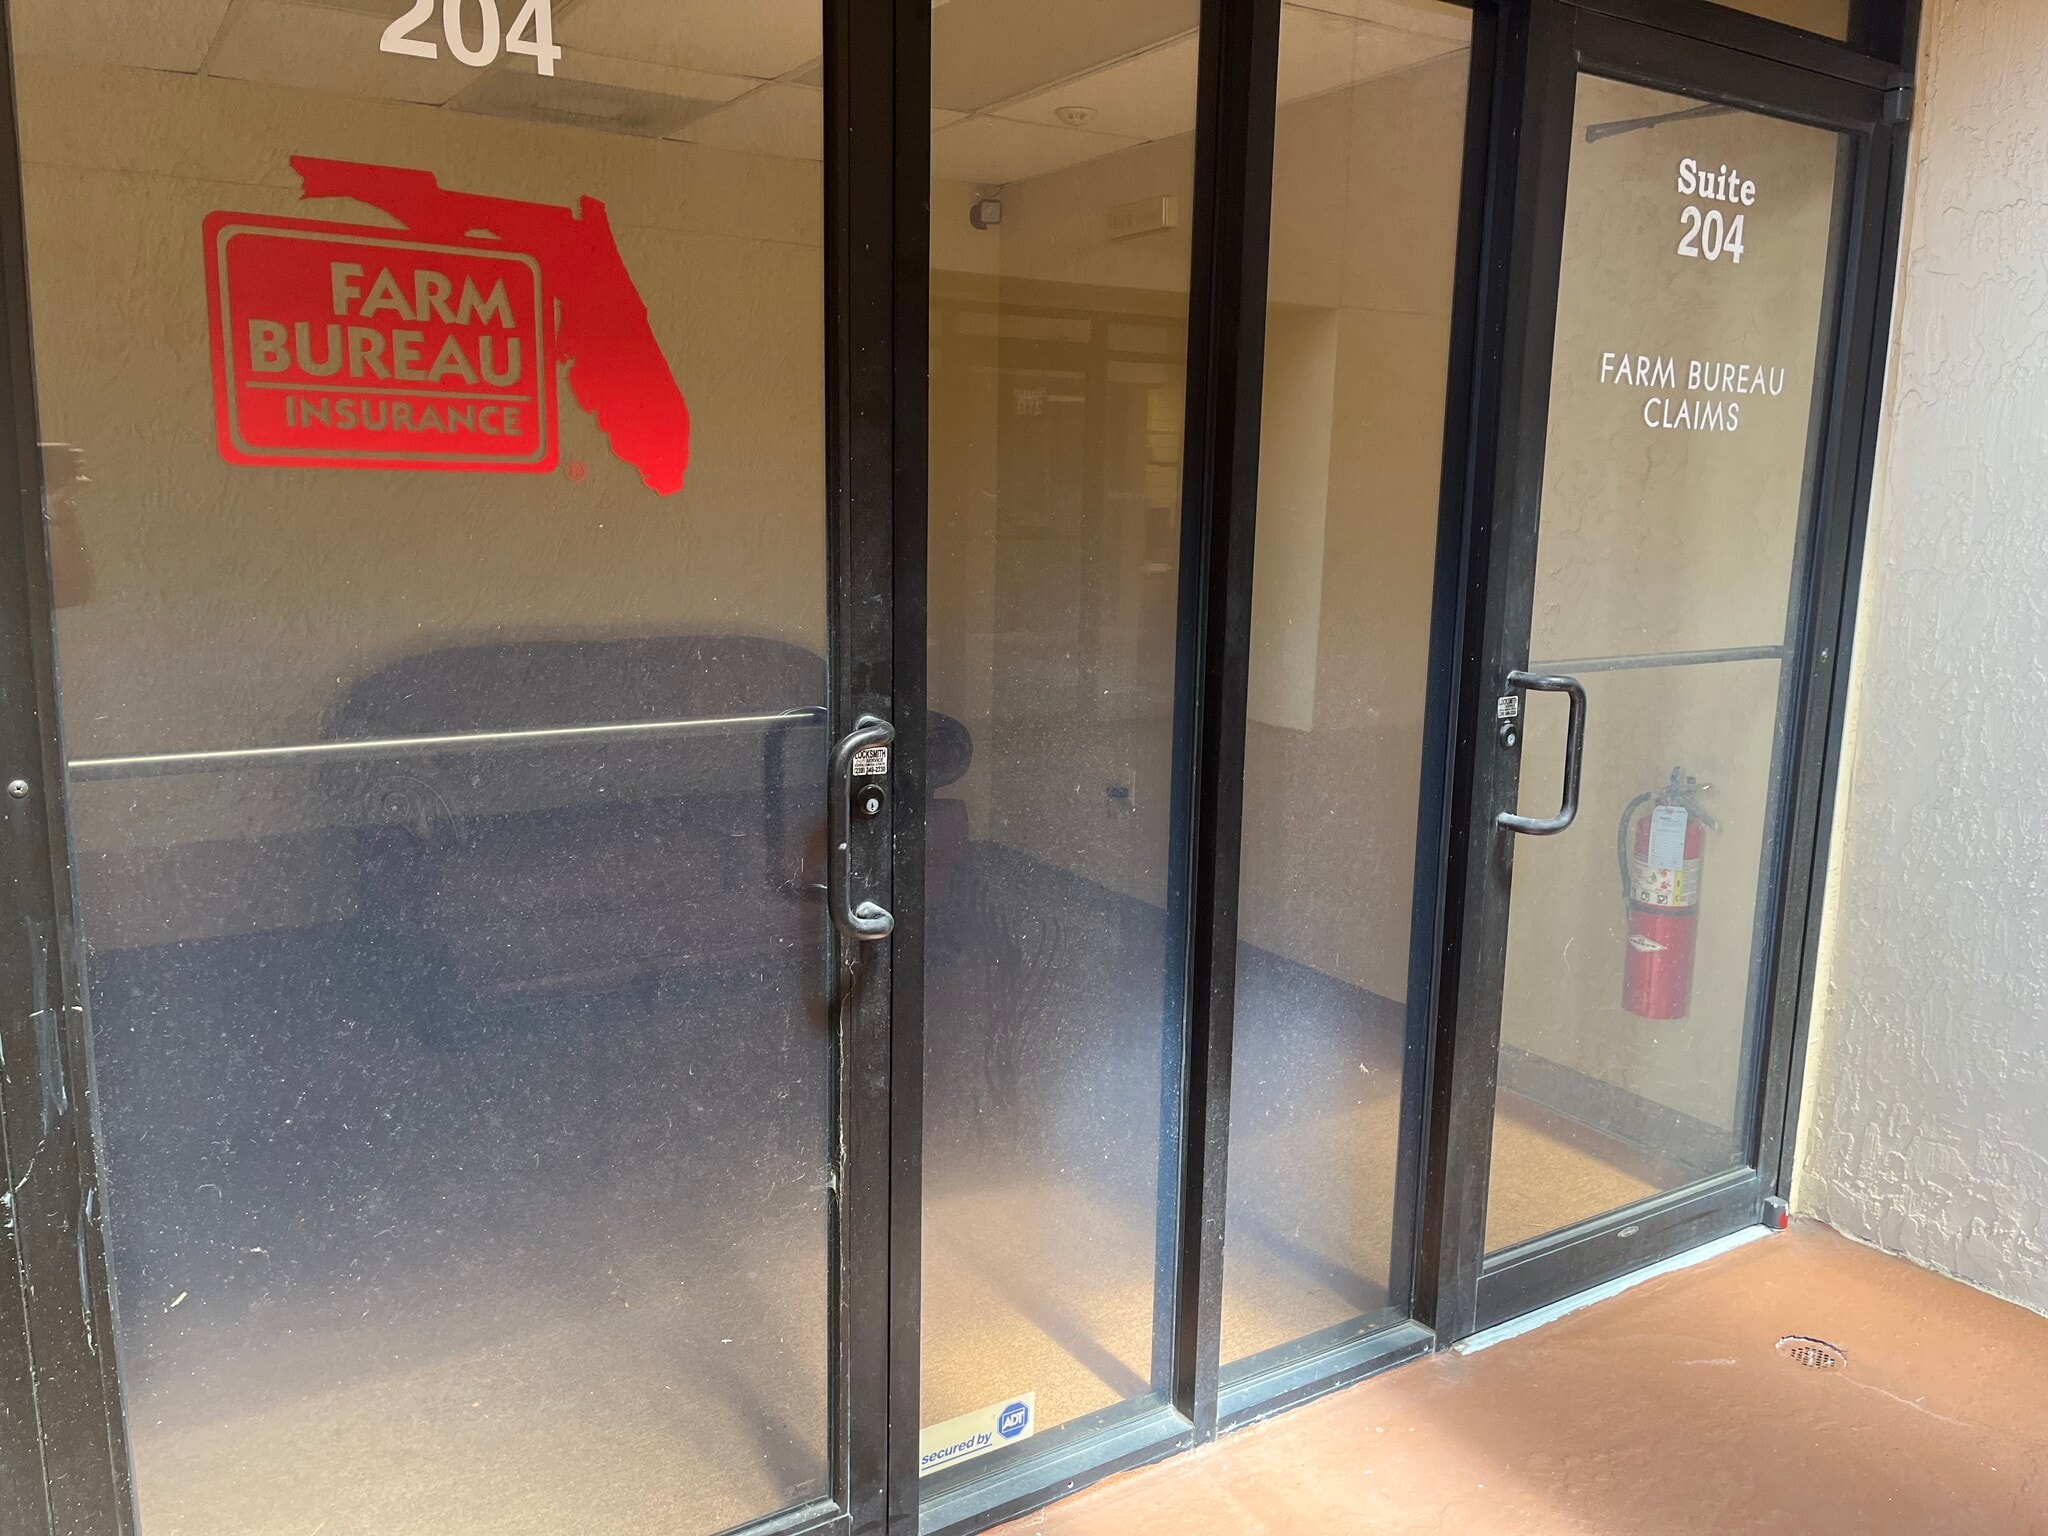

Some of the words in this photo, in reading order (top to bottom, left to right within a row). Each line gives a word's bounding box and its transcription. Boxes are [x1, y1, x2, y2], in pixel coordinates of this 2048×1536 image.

[379, 0, 562, 76] 204
[1678, 158, 1756, 206] Suite
[1677, 206, 1745, 264] 204
[330, 261, 516, 329] FARM
[248, 319, 522, 387] BUREAU
[1600, 352, 1675, 389] FARM
[1688, 360, 1784, 396] BUREAU
[284, 396, 522, 436] INSURANCE
[1644, 397, 1739, 432] CLAIMS
[1003, 1413, 1024, 1429] ADT
[921, 1436, 975, 1465] secured
[977, 1433, 992, 1445] by
